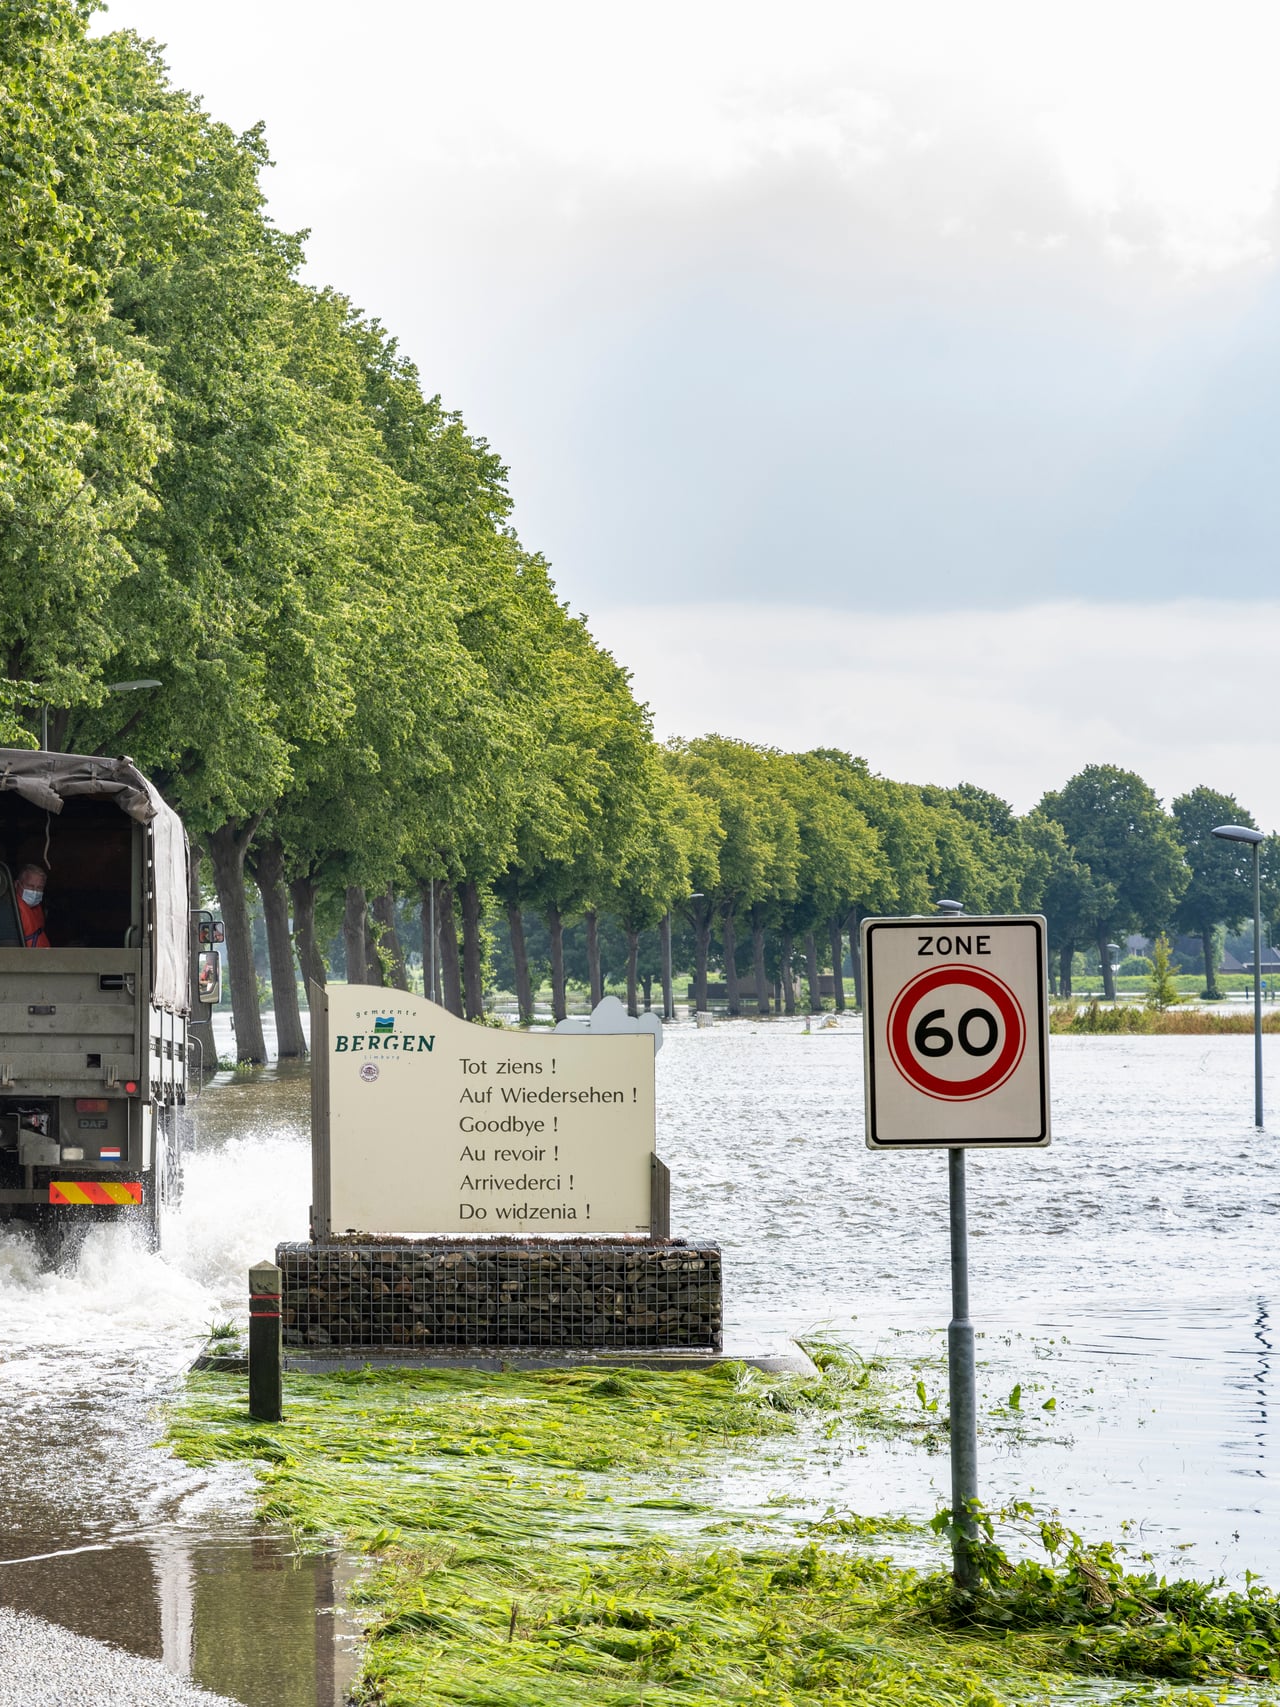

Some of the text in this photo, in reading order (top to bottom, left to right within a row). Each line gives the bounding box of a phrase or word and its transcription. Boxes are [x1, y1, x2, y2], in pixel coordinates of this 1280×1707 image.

[917, 935, 992, 956] ZONE
[355, 1009, 417, 1019] gemeente
[914, 1008, 999, 1058] 60
[334, 1035, 436, 1053] BERGEN
[459, 1058, 556, 1075] Tot ziens !
[459, 1086, 637, 1104] Auf Wiedersehen !
[80, 1120, 107, 1129] DAF
[459, 1115, 558, 1137] Goodbye !
[459, 1145, 559, 1162] Au revoir !
[459, 1173, 574, 1191] Arrivederci !
[459, 1203, 591, 1220] Do widzenia !
